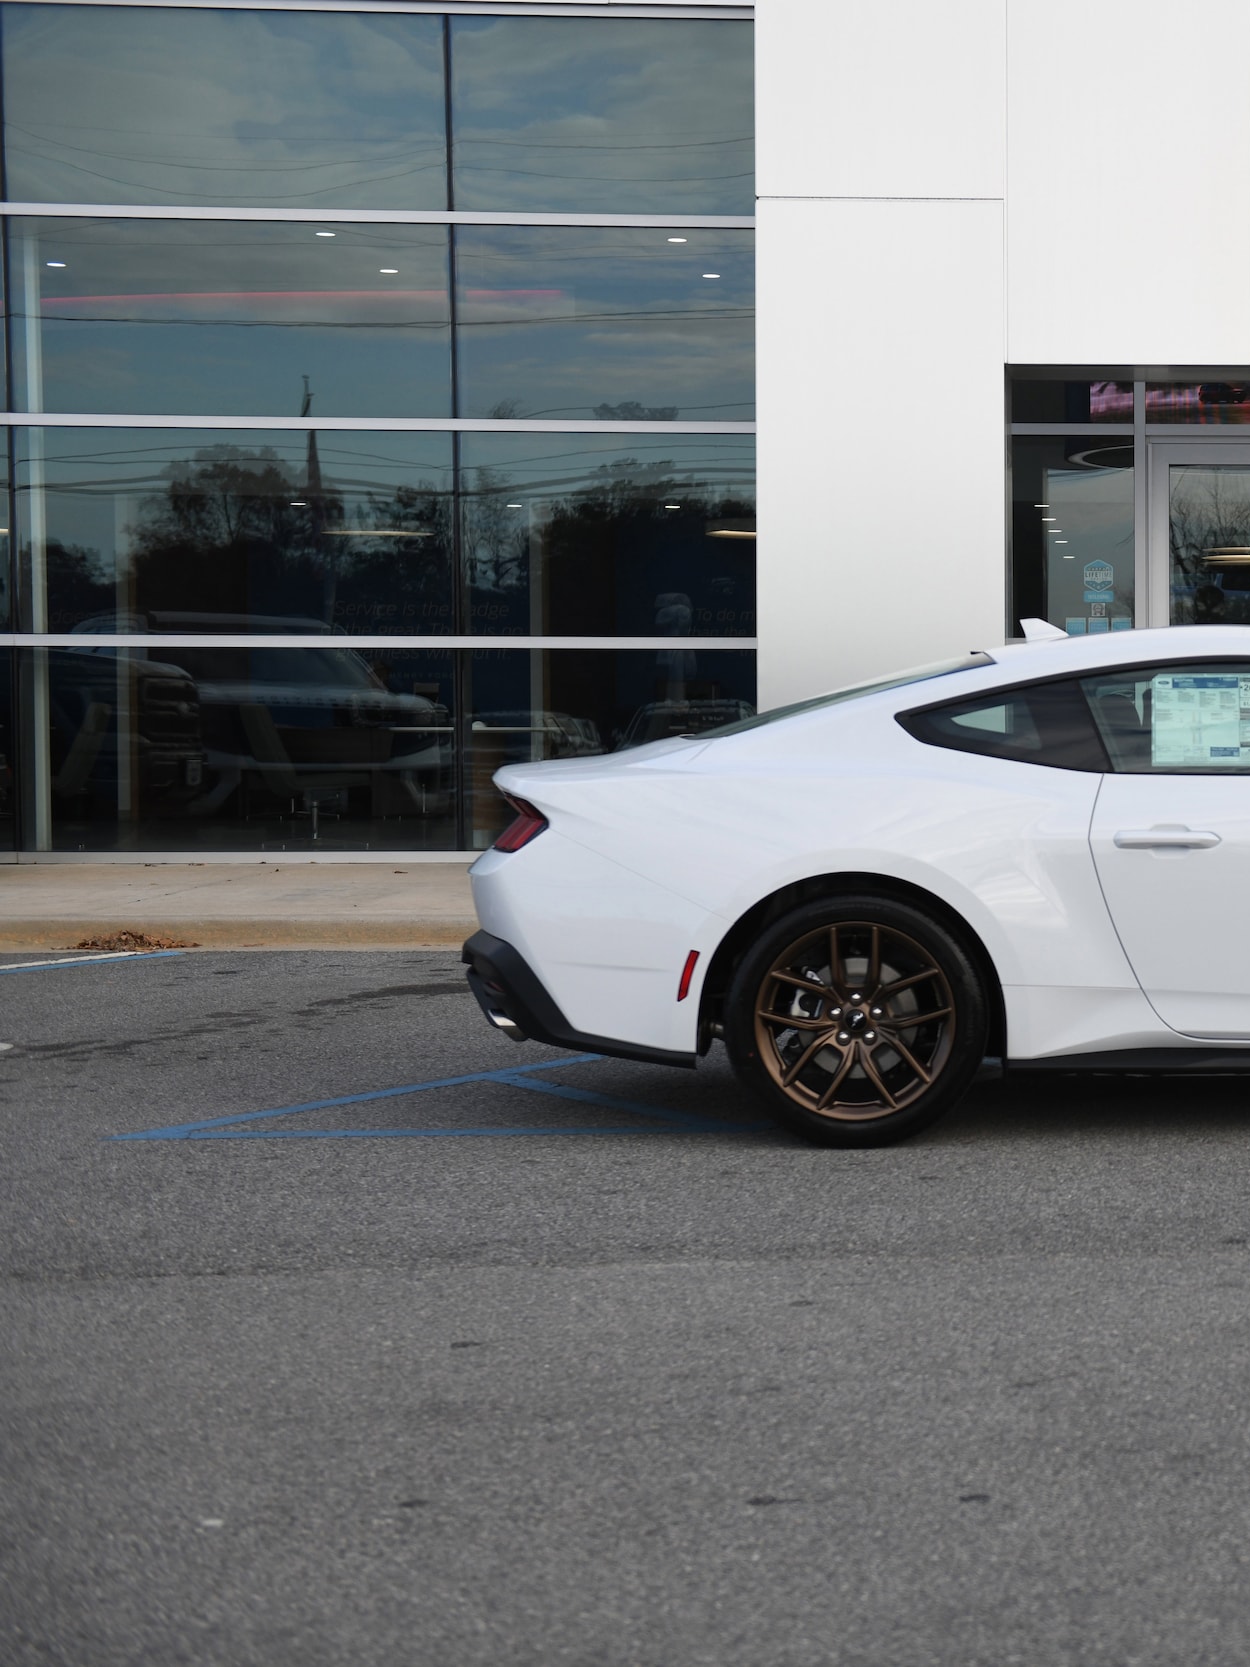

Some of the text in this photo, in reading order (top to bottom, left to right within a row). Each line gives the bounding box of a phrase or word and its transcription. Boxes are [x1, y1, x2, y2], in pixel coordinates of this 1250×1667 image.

[335, 600, 510, 620] Service is the adge
[429, 623, 477, 635] The
